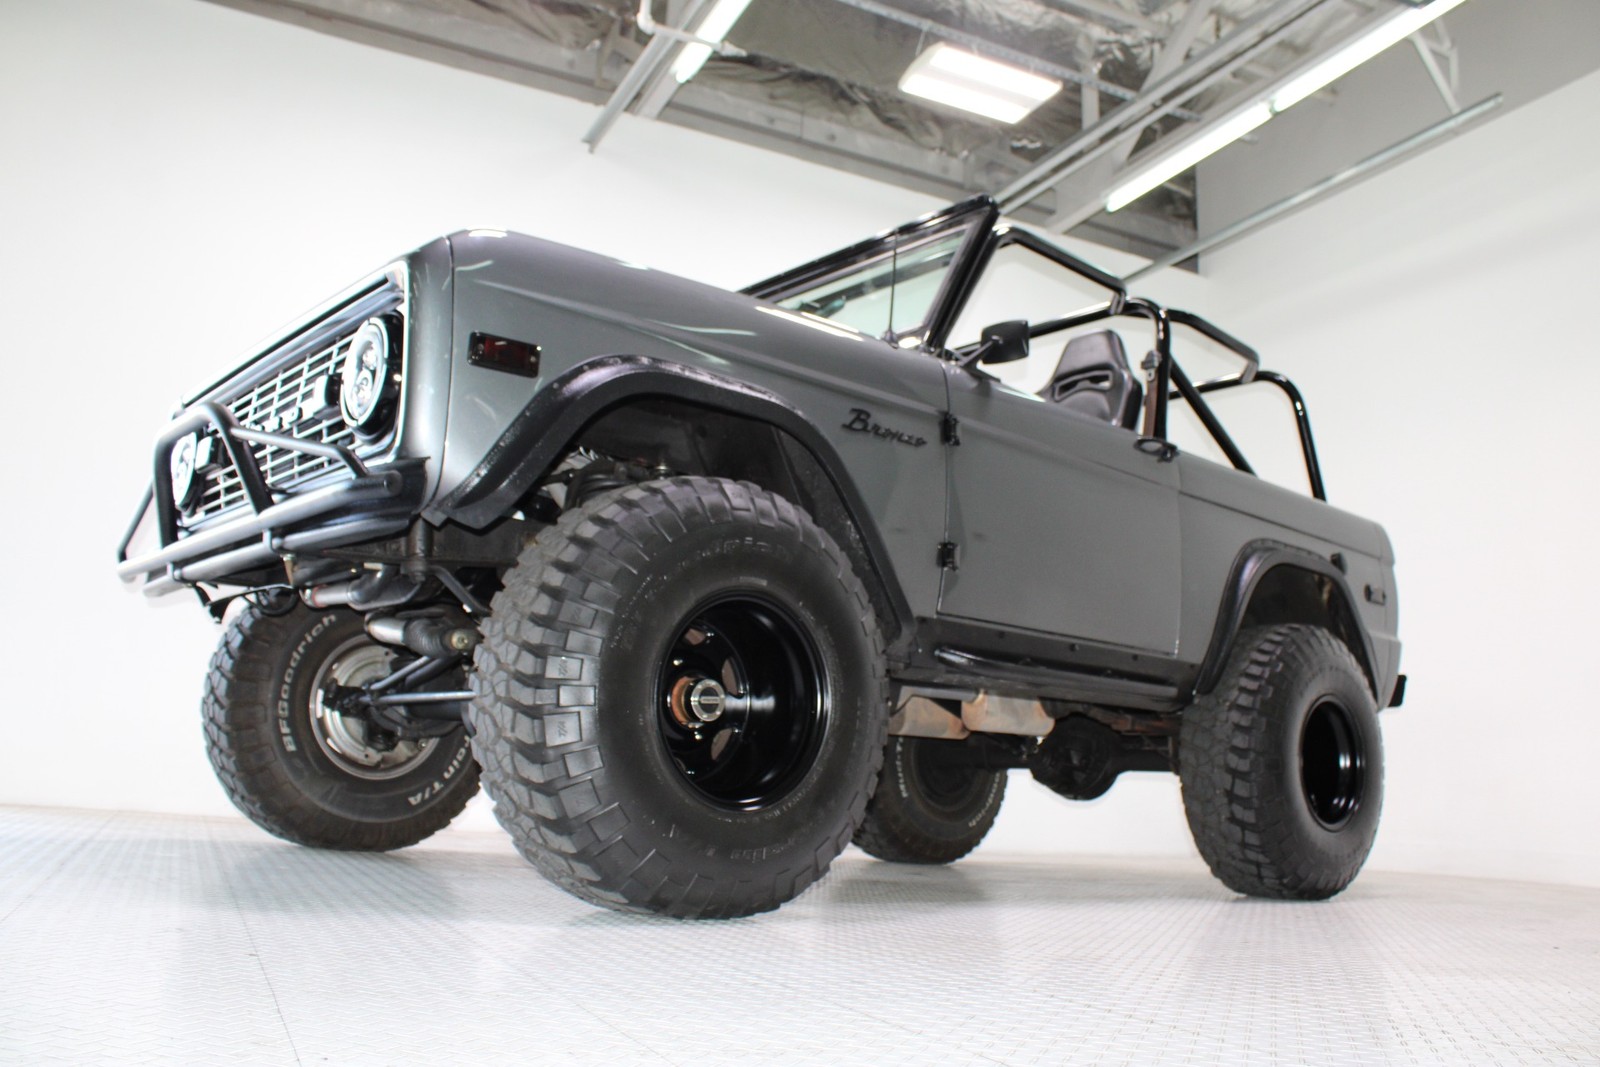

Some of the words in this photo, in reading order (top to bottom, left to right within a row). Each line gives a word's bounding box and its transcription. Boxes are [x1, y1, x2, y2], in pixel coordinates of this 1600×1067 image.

[841, 408, 927, 447] Bronco
[278, 614, 336, 752] BFGoodrich
[408, 781, 444, 806] T/A
